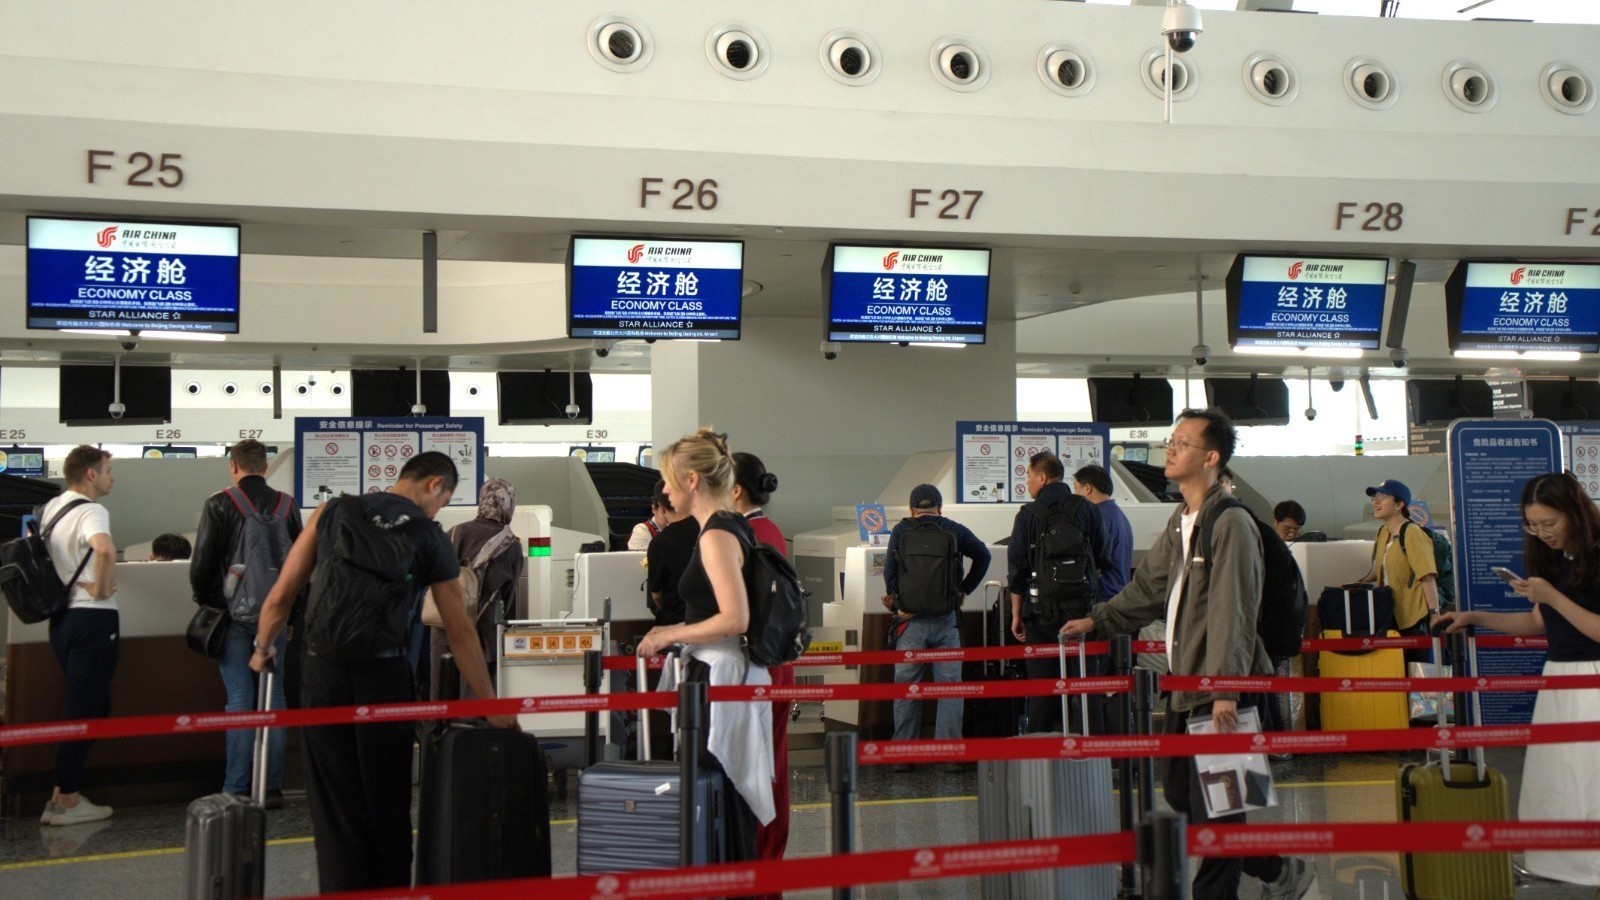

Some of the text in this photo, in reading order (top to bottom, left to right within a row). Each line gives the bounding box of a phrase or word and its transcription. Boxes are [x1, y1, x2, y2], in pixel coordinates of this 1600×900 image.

[122, 230, 176, 240] AIR CHINA
[648, 247, 663, 255] AIR
[902, 254, 943, 263] AIR CHINA
[85, 255, 186, 284] 经济舱
[1320, 264, 1344, 272] CHINA
[617, 271, 699, 296] 经济舱
[872, 277, 949, 301] 经济舱
[78, 288, 192, 301] ECONOMY CLASS
[1277, 286, 1348, 309] 经济舱
[611, 301, 703, 310] ECONOMY CLASS
[1499, 291, 1568, 314] 经济舱
[867, 305, 952, 316] ECONOMY CLASS
[89, 311, 169, 320] STAR ALLIANCE
[1271, 313, 1349, 323] ECONOMY CLASS
[1493, 318, 1569, 327] ECONOMY CLASS
[896, 325, 933, 333] ALLIANCE
[319, 421, 373, 429] 安全信息提示
[1473, 438, 1538, 447] 危险品收运告知书
